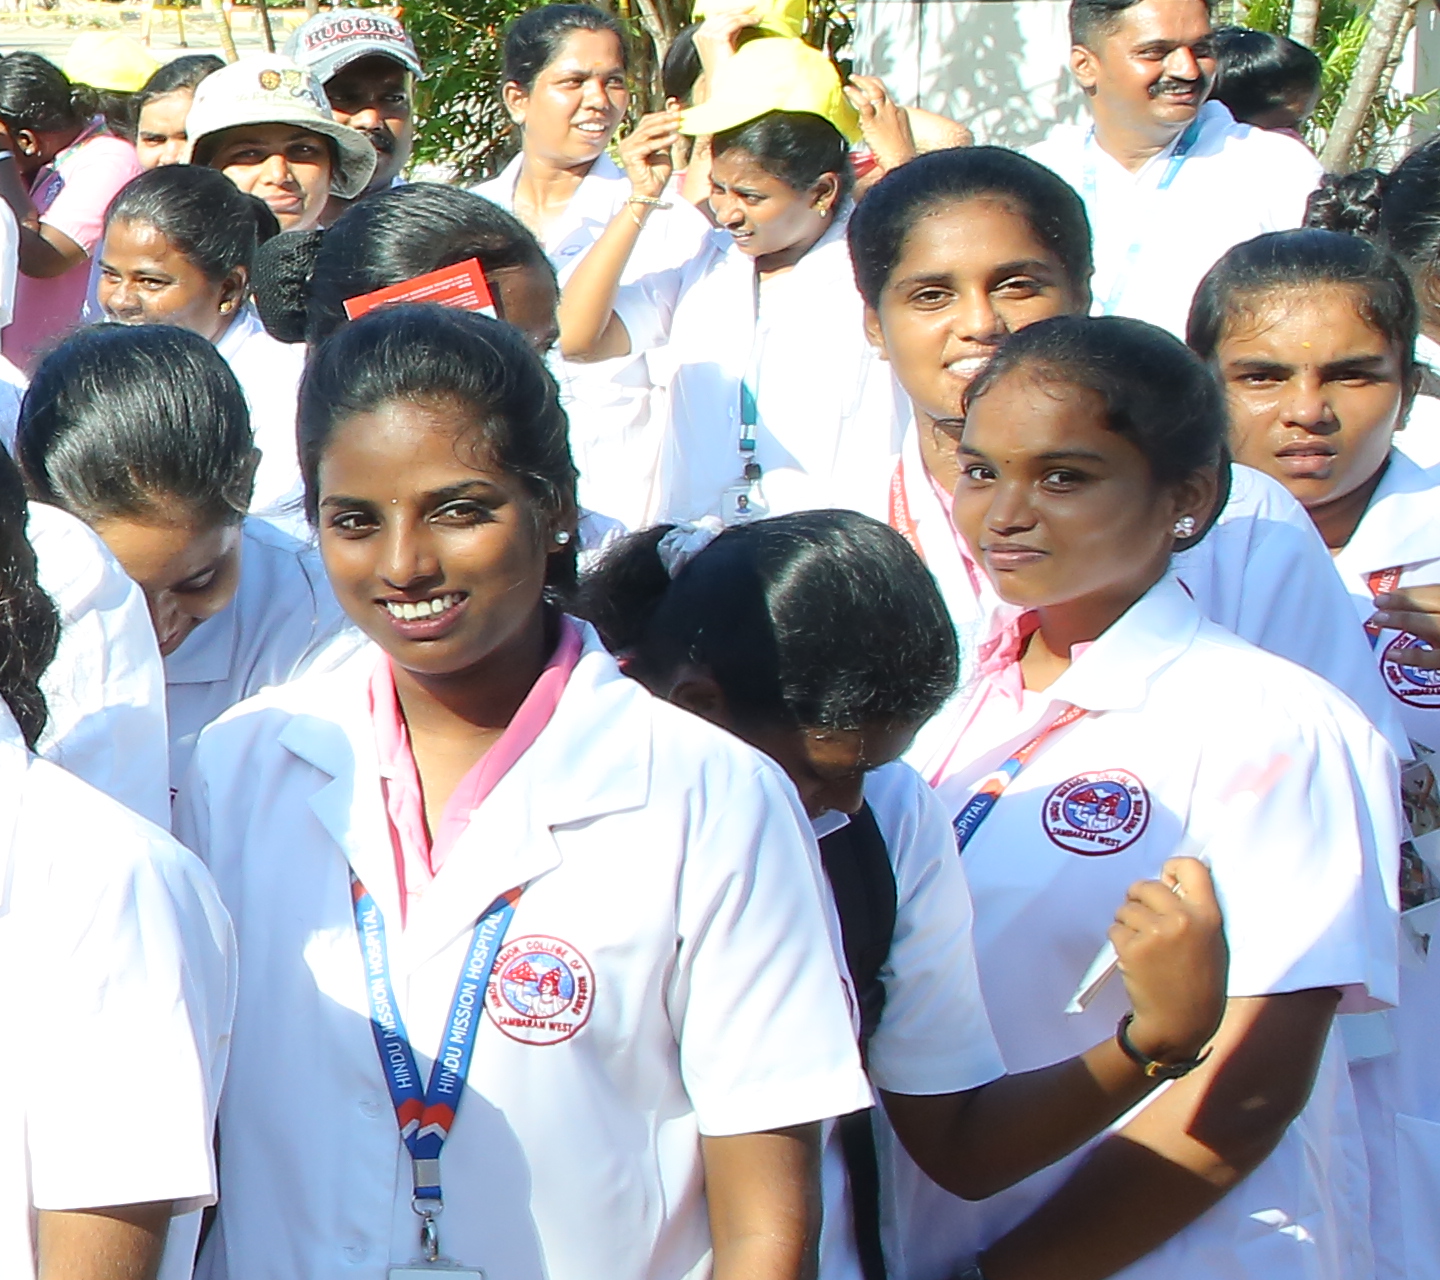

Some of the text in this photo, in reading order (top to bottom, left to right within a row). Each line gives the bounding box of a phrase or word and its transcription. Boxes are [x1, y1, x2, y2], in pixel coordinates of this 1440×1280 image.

[956, 799, 988, 837] SPITAL
[362, 904, 413, 1090] HINDU MISSION HOSPITAL
[437, 911, 504, 1094] HINDU MISSION HOSPITAL
[548, 1021, 573, 1033] WEST
